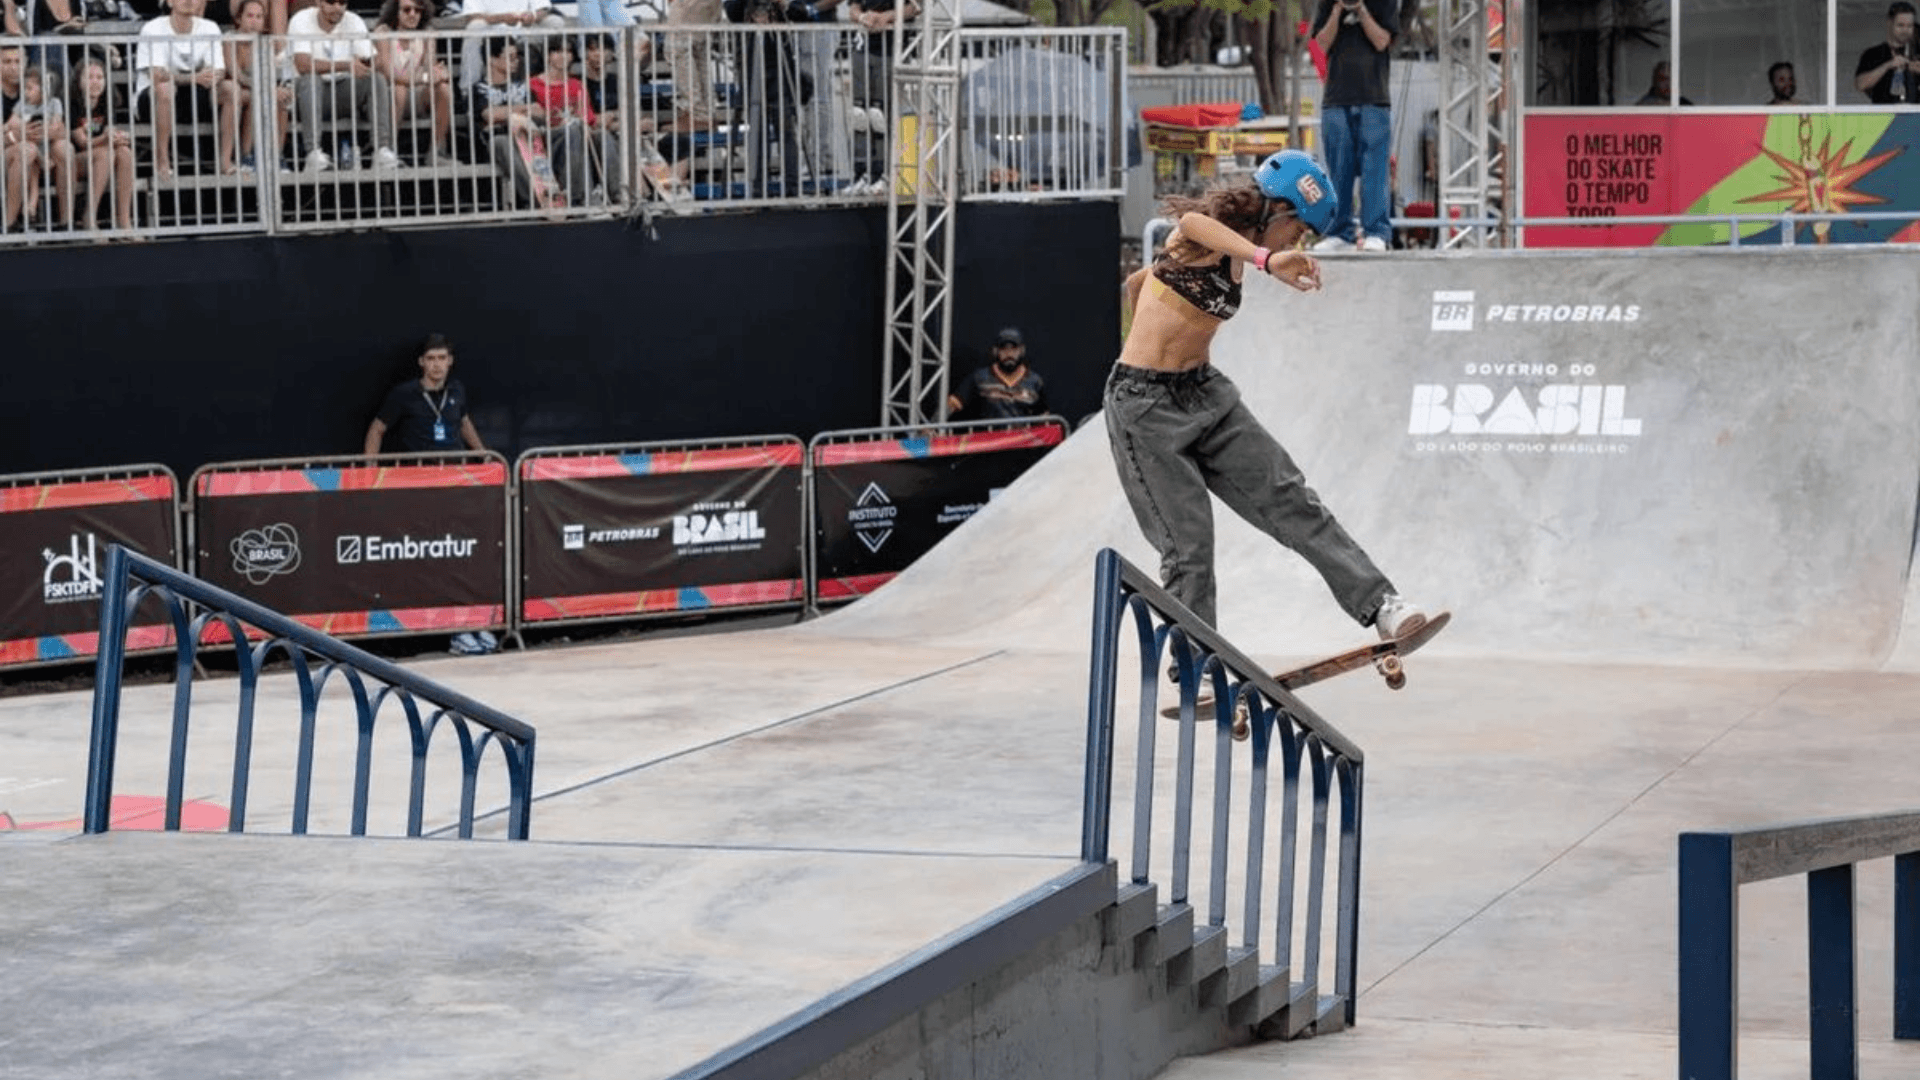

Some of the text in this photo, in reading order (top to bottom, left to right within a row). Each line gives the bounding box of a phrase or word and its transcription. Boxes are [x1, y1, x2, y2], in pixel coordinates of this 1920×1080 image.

[1566, 134, 1662, 156] O MELHOR
[1567, 158, 1655, 180] DO SKATE
[1566, 182, 1649, 204] O TEMPO
[1436, 304, 1641, 322] BR PETROBRAS
[1464, 363, 1596, 376] GOVERNO DO
[1407, 383, 1642, 436] BRASIL
[848, 506, 898, 520] INSTITUTO
[589, 527, 660, 542] PETROBRAS
[673, 510, 766, 545] BRASIL
[249, 548, 286, 561] BRASIL
[366, 534, 477, 561] Embratur
